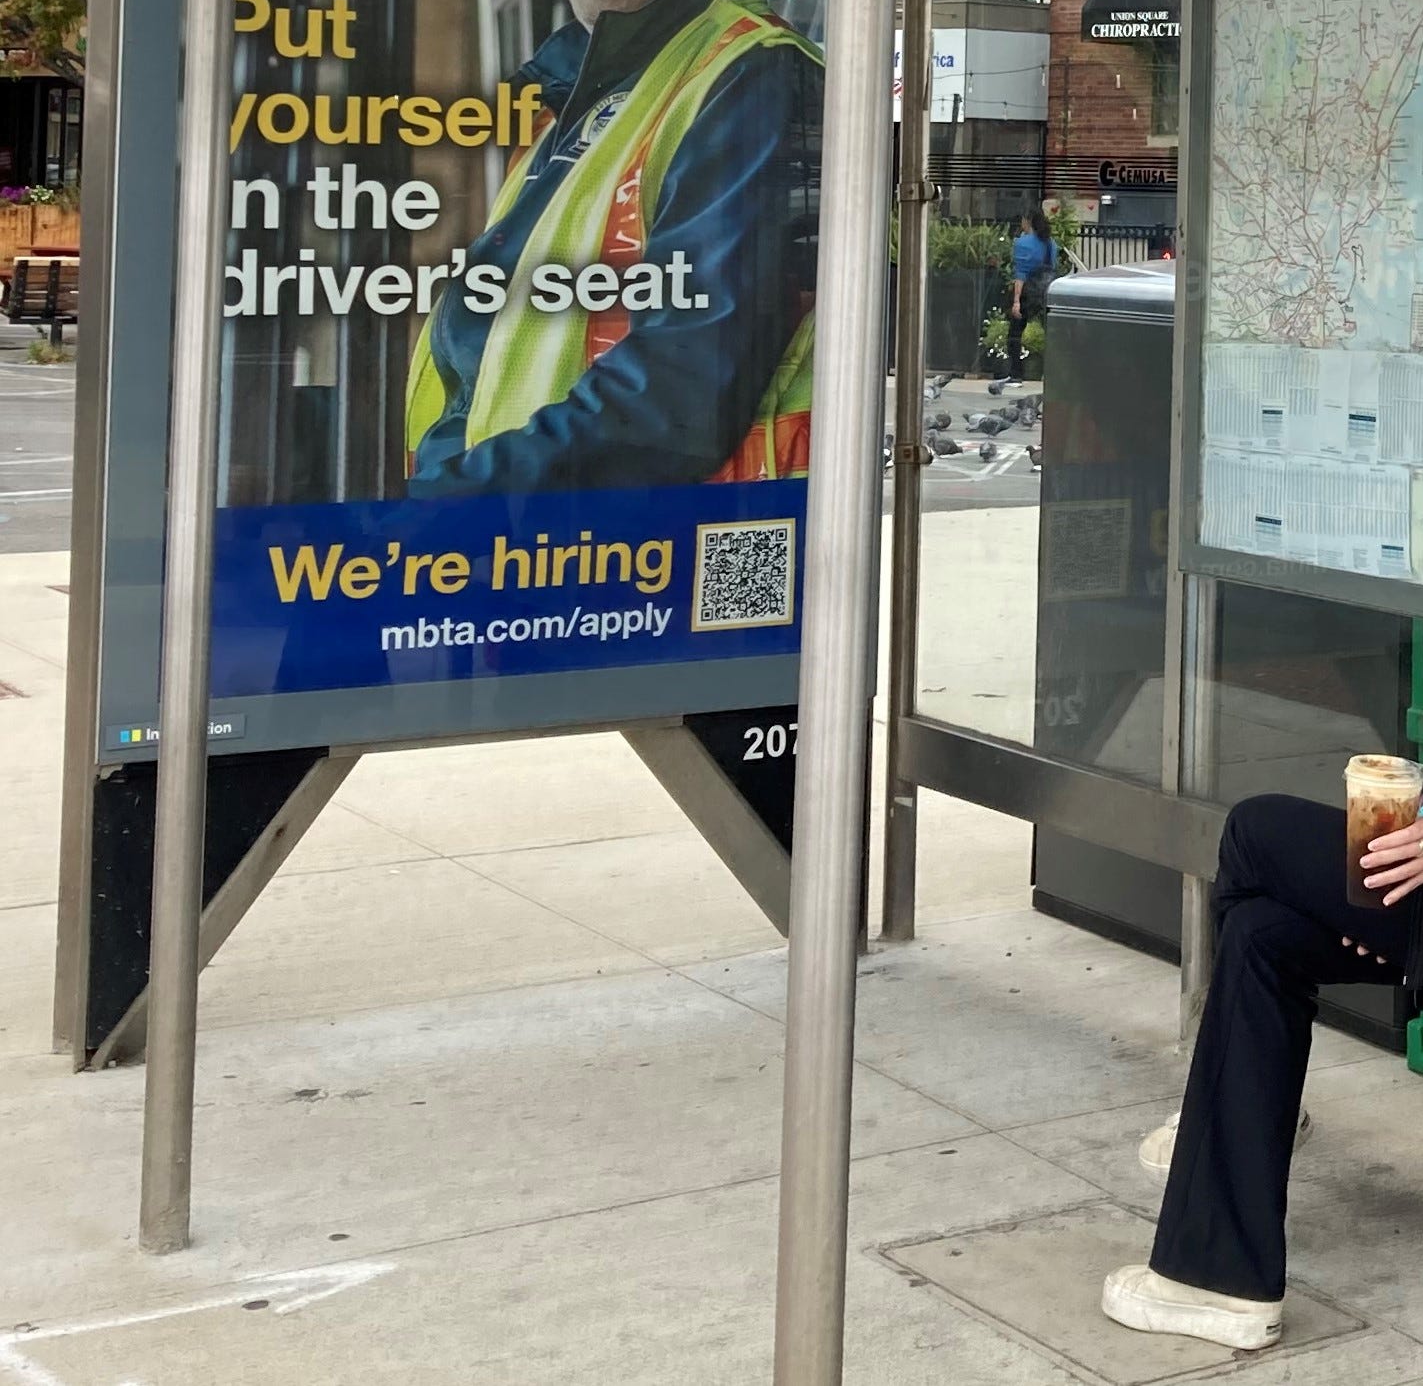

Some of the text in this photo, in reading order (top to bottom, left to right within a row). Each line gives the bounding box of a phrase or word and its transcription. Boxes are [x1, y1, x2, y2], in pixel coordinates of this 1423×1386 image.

[1091, 22, 1182, 38] CHIROPRACTI
[1111, 11, 1169, 21] UNION SQUARE
[230, 82, 542, 153] yourself
[230, 163, 439, 230] n the
[1118, 165, 1166, 184] CEMUSA
[224, 249, 710, 317] driver's seat.
[492, 530, 673, 596] hiring
[382, 601, 673, 652] mbta.com/apply
